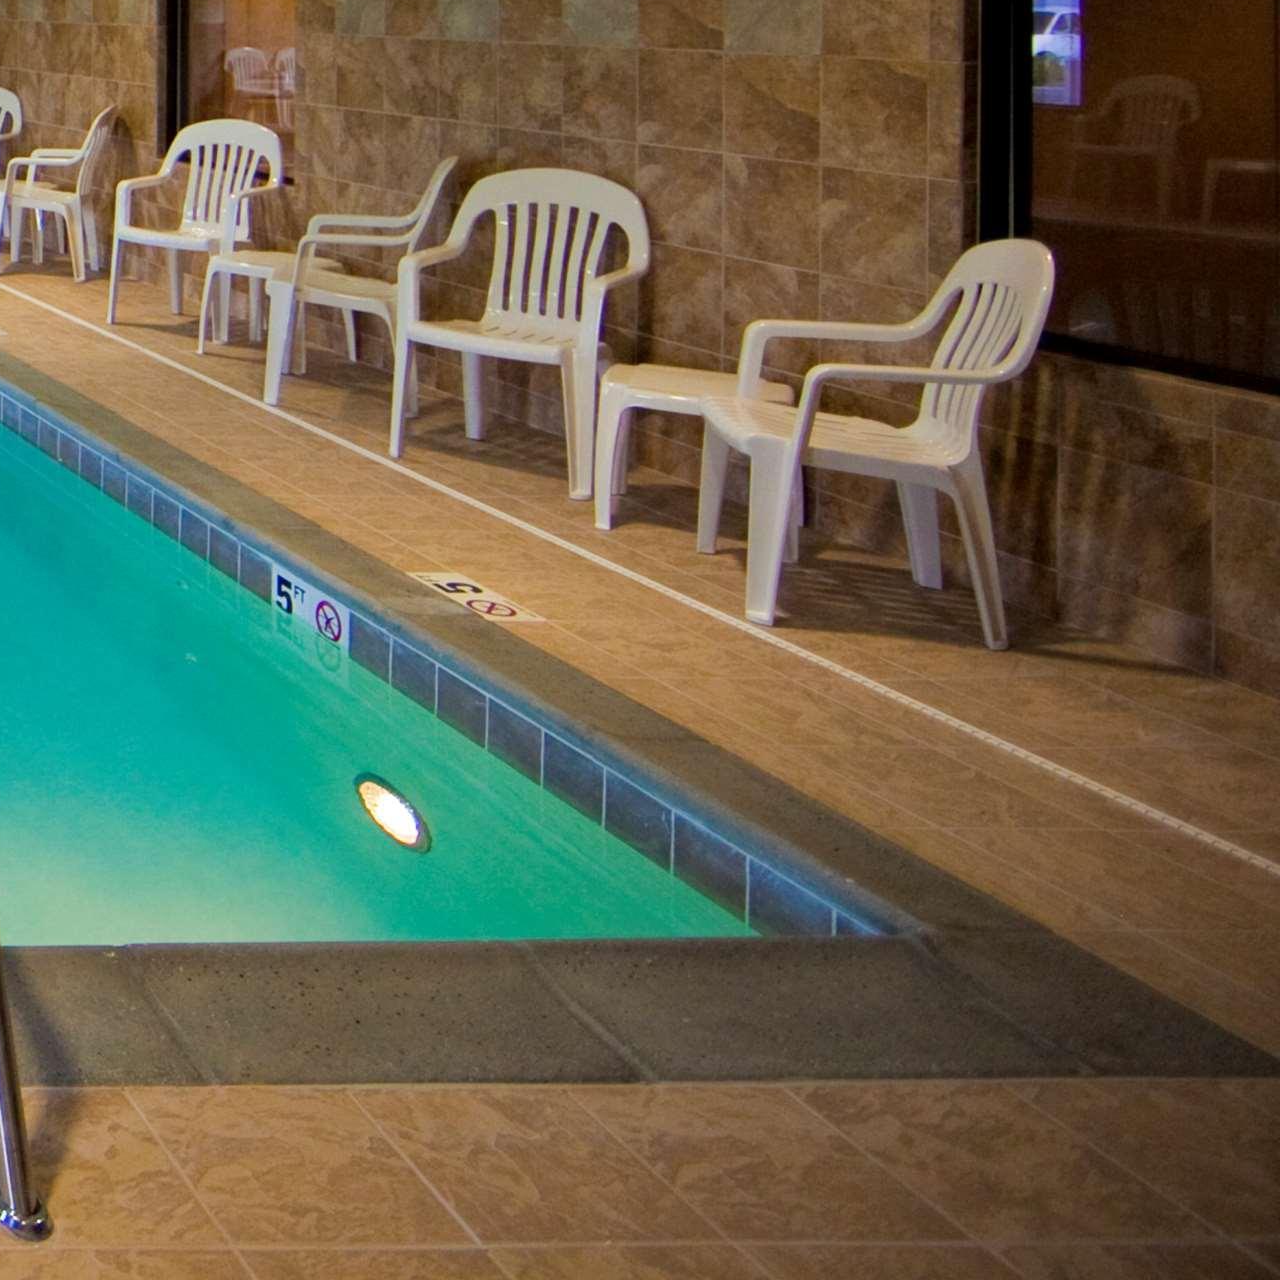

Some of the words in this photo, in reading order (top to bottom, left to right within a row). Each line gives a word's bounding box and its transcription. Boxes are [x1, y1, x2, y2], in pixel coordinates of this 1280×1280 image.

[276, 574, 293, 615] 5
[294, 585, 305, 604] FT
[432, 582, 483, 593] 5
